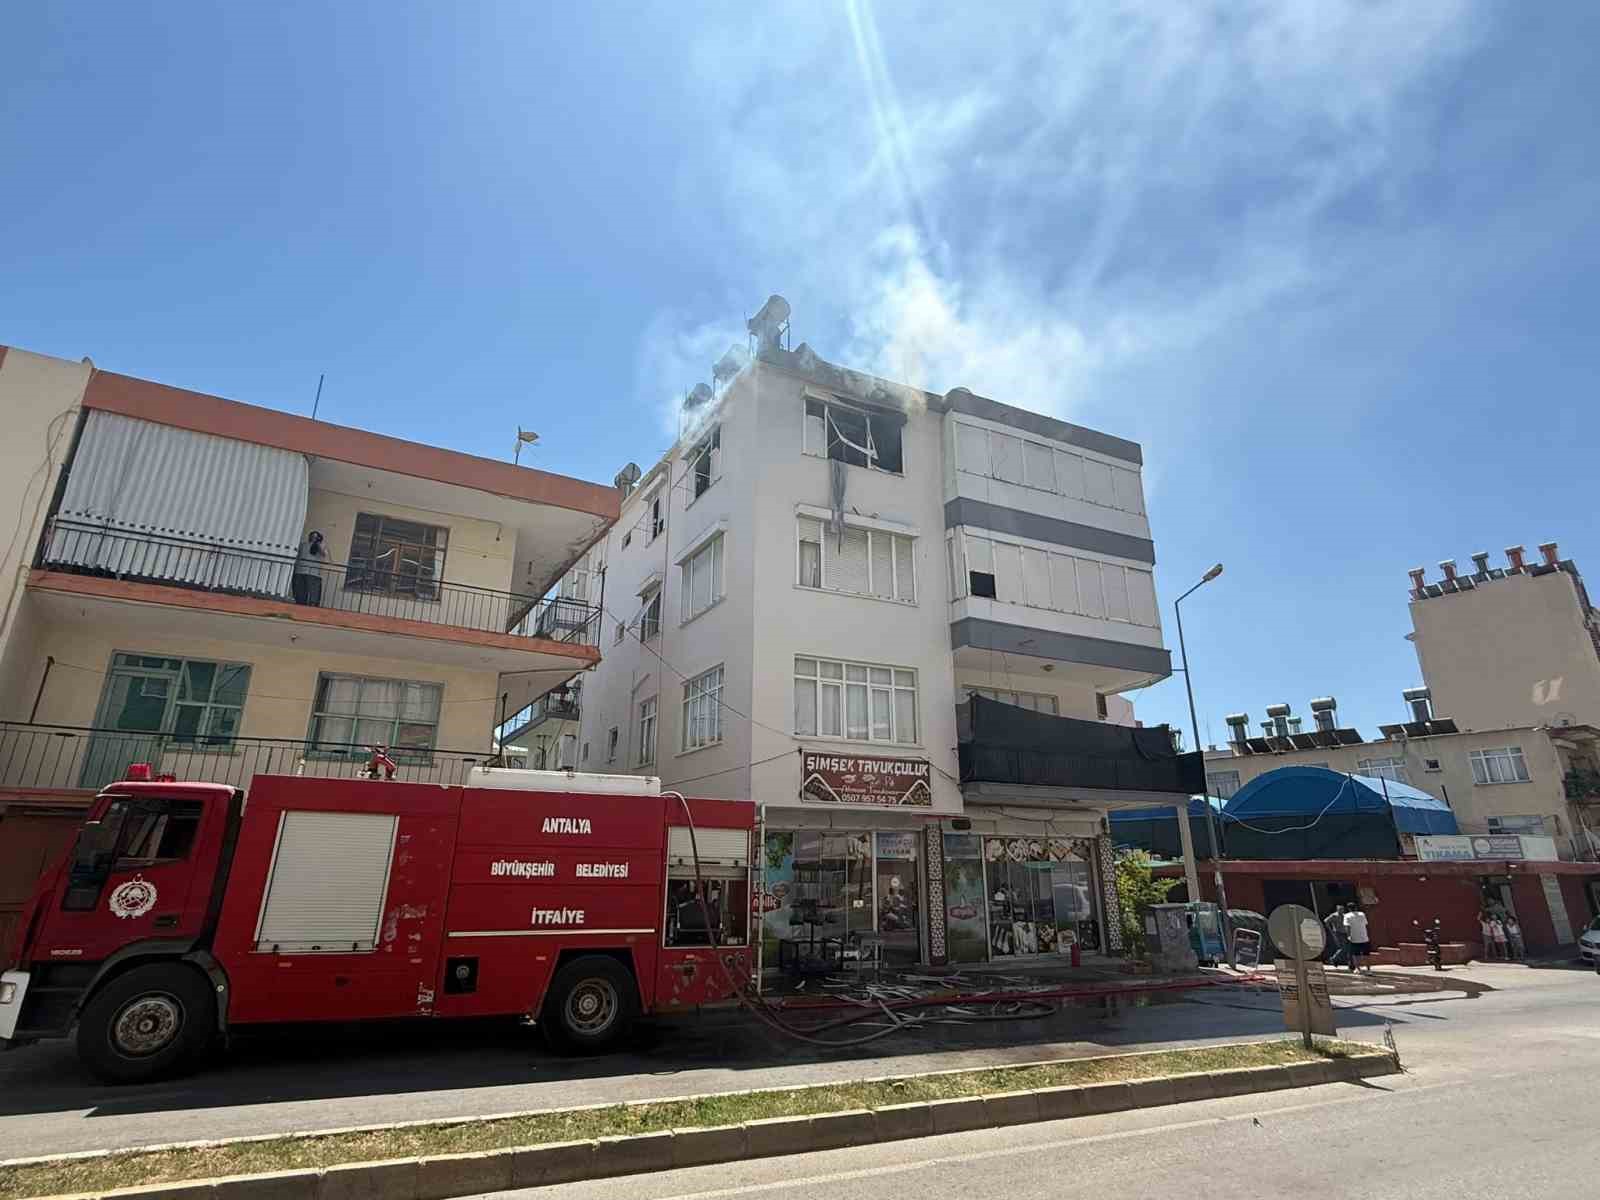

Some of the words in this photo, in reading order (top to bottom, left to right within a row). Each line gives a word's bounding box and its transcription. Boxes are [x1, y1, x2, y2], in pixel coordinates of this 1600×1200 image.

[806, 754, 855, 774] ŞİMŞEK
[857, 759, 929, 776] TAVUKÇULUK
[542, 817, 592, 834] ANTALYA
[491, 859, 555, 879] BÜYÜKŞEHİR
[576, 861, 629, 878] BELEDİYESİ
[531, 907, 585, 924] İTFAİYE
